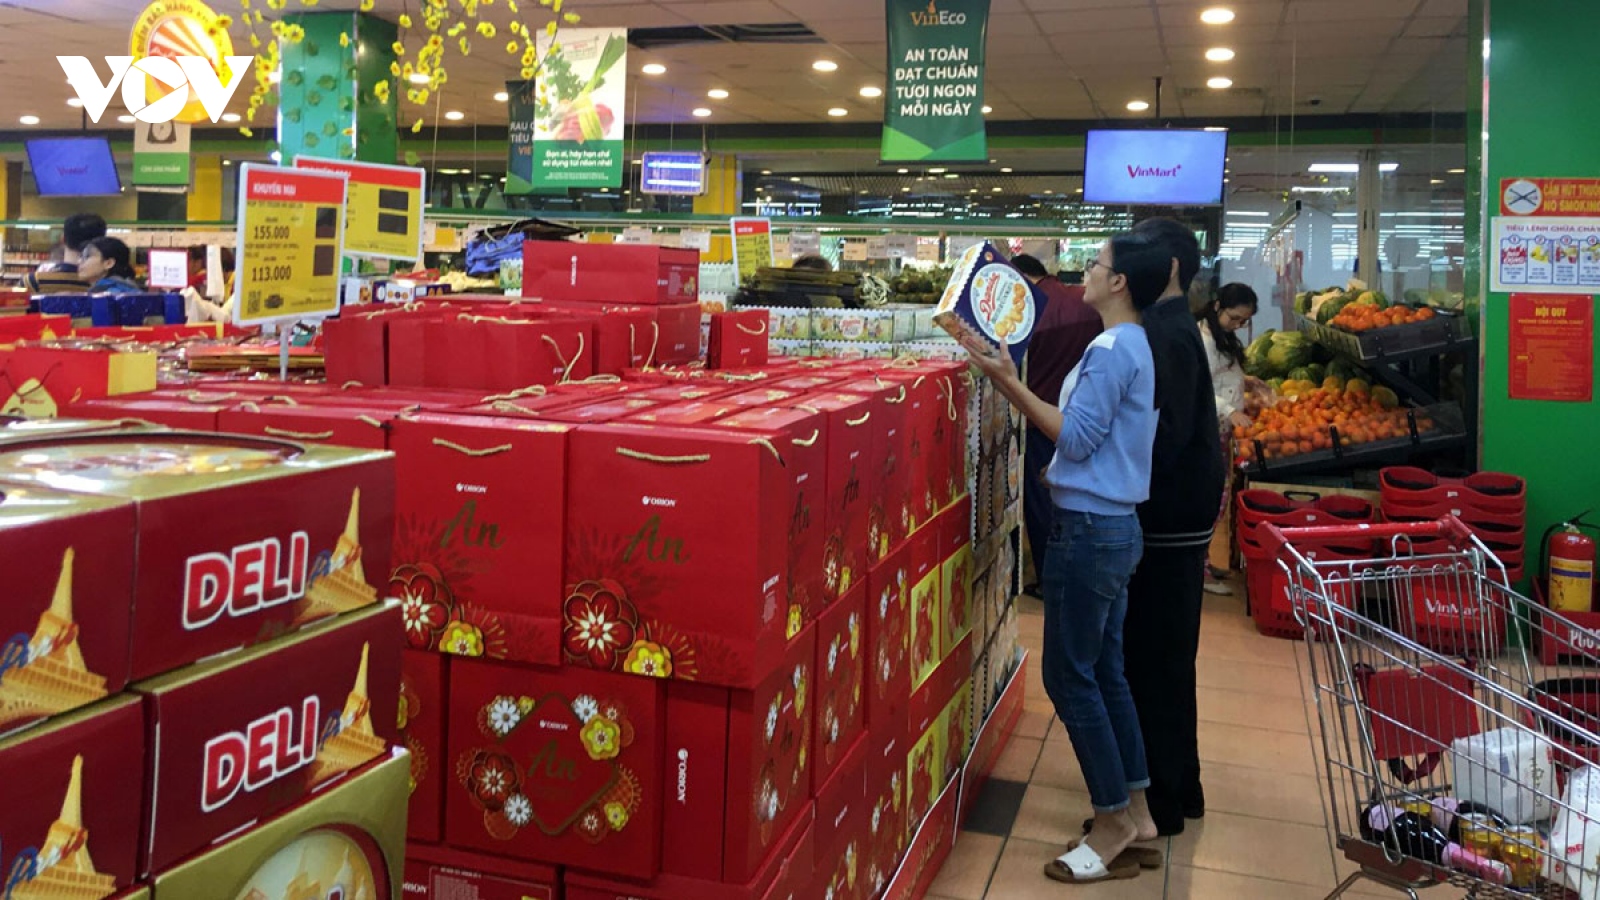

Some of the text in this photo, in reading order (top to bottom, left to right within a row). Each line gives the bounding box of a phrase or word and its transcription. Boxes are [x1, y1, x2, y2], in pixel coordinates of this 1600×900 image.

[911, 10, 966, 26] VinEco
[905, 45, 969, 61] AN TOÀN
[896, 61, 978, 83] ĐẠT CHUẨN
[896, 83, 977, 98] TƯƠI NGON
[901, 99, 972, 117] MỖI NGÀY
[1579, 182, 1600, 196] THUỐ
[1544, 200, 1557, 212] NO
[254, 226, 290, 240] 155.000
[252, 266, 292, 281] 113.000
[1536, 305, 1567, 318] NỘI QUY
[440, 500, 505, 549] An
[622, 514, 690, 565] An
[182, 531, 309, 631] DELI
[1425, 597, 1487, 614] VinMar
[201, 695, 320, 812] DELI
[677, 761, 687, 804] ORION
